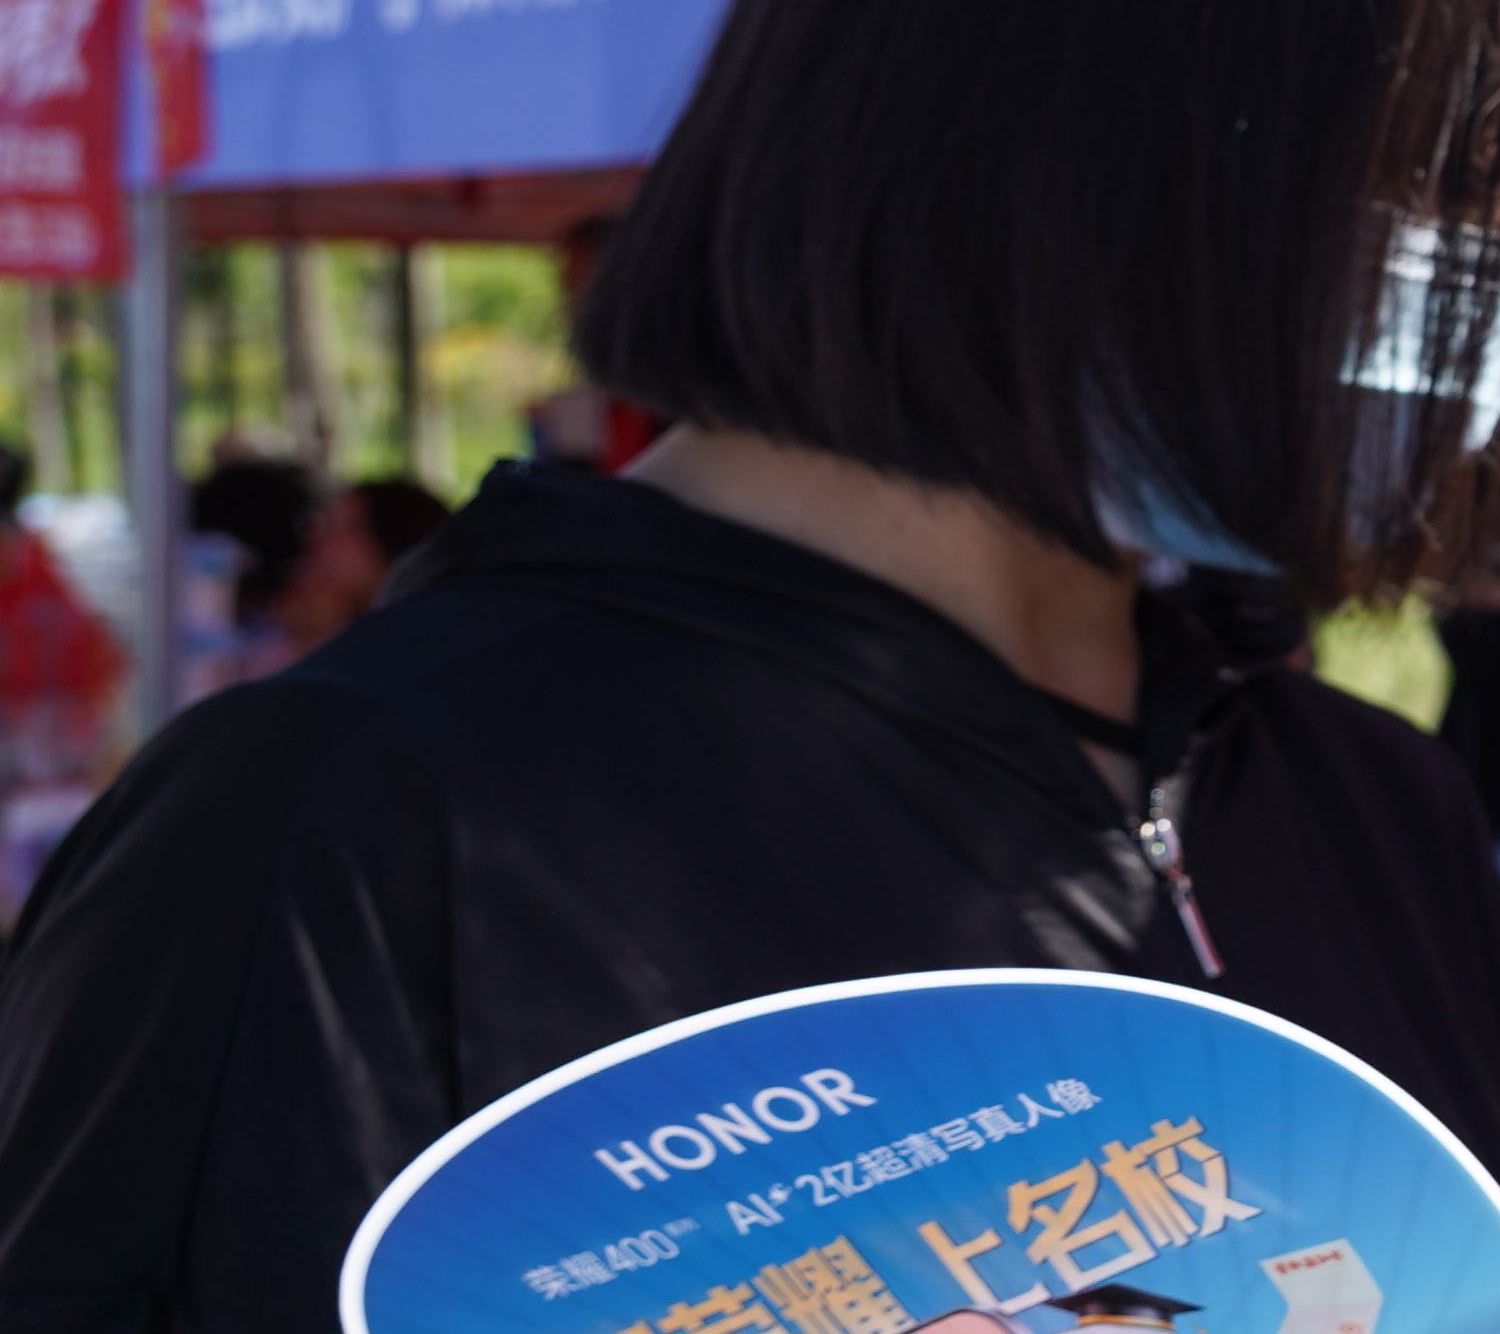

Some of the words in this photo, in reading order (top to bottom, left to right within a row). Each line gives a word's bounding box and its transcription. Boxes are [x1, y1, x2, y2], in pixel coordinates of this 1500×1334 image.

[592, 1066, 880, 1191] HONOR
[914, 1114, 1265, 1317] 上名校
